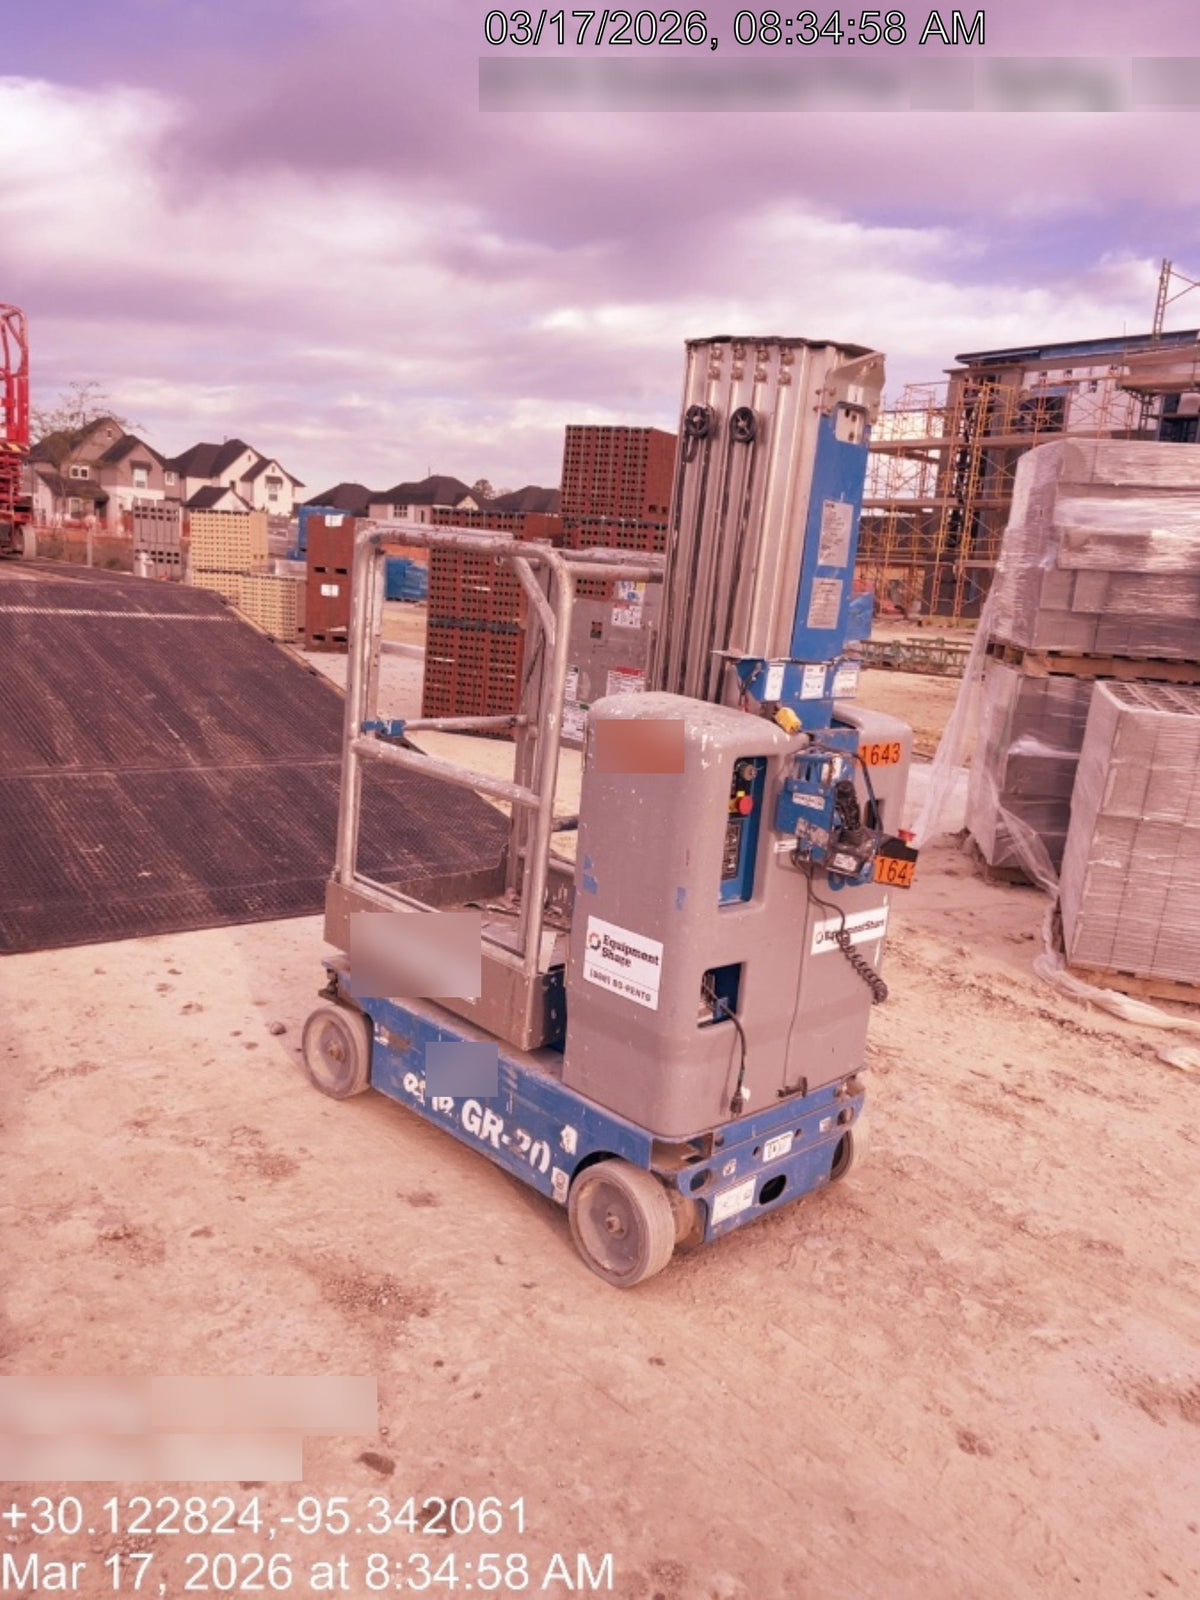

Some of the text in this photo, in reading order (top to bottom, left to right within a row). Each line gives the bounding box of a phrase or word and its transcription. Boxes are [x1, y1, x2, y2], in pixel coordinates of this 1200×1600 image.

[860, 742, 901, 766] 1643
[602, 947, 632, 969] Share
[603, 934, 660, 967] Equipment
